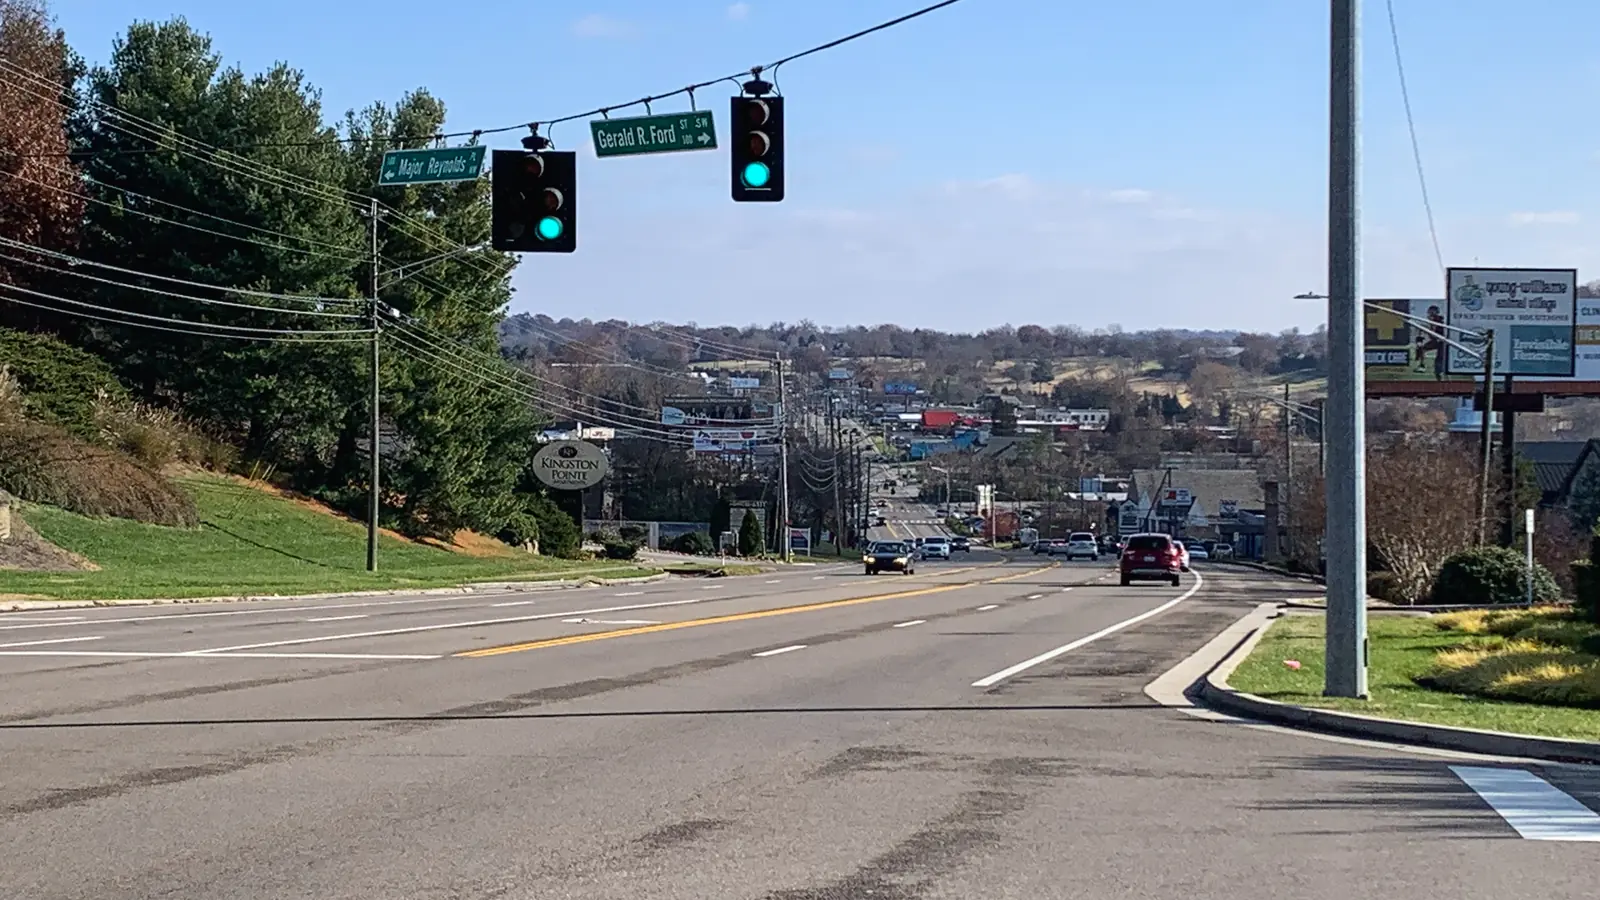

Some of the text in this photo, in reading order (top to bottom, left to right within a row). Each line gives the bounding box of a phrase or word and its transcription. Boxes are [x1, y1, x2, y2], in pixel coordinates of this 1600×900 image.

[680, 118, 708, 130] ST SW
[597, 123, 677, 149] Gerald R. Ford
[398, 155, 467, 179] Major Reynolds
[541, 457, 599, 470] KINGSTON
[552, 469, 588, 481] POINTE
